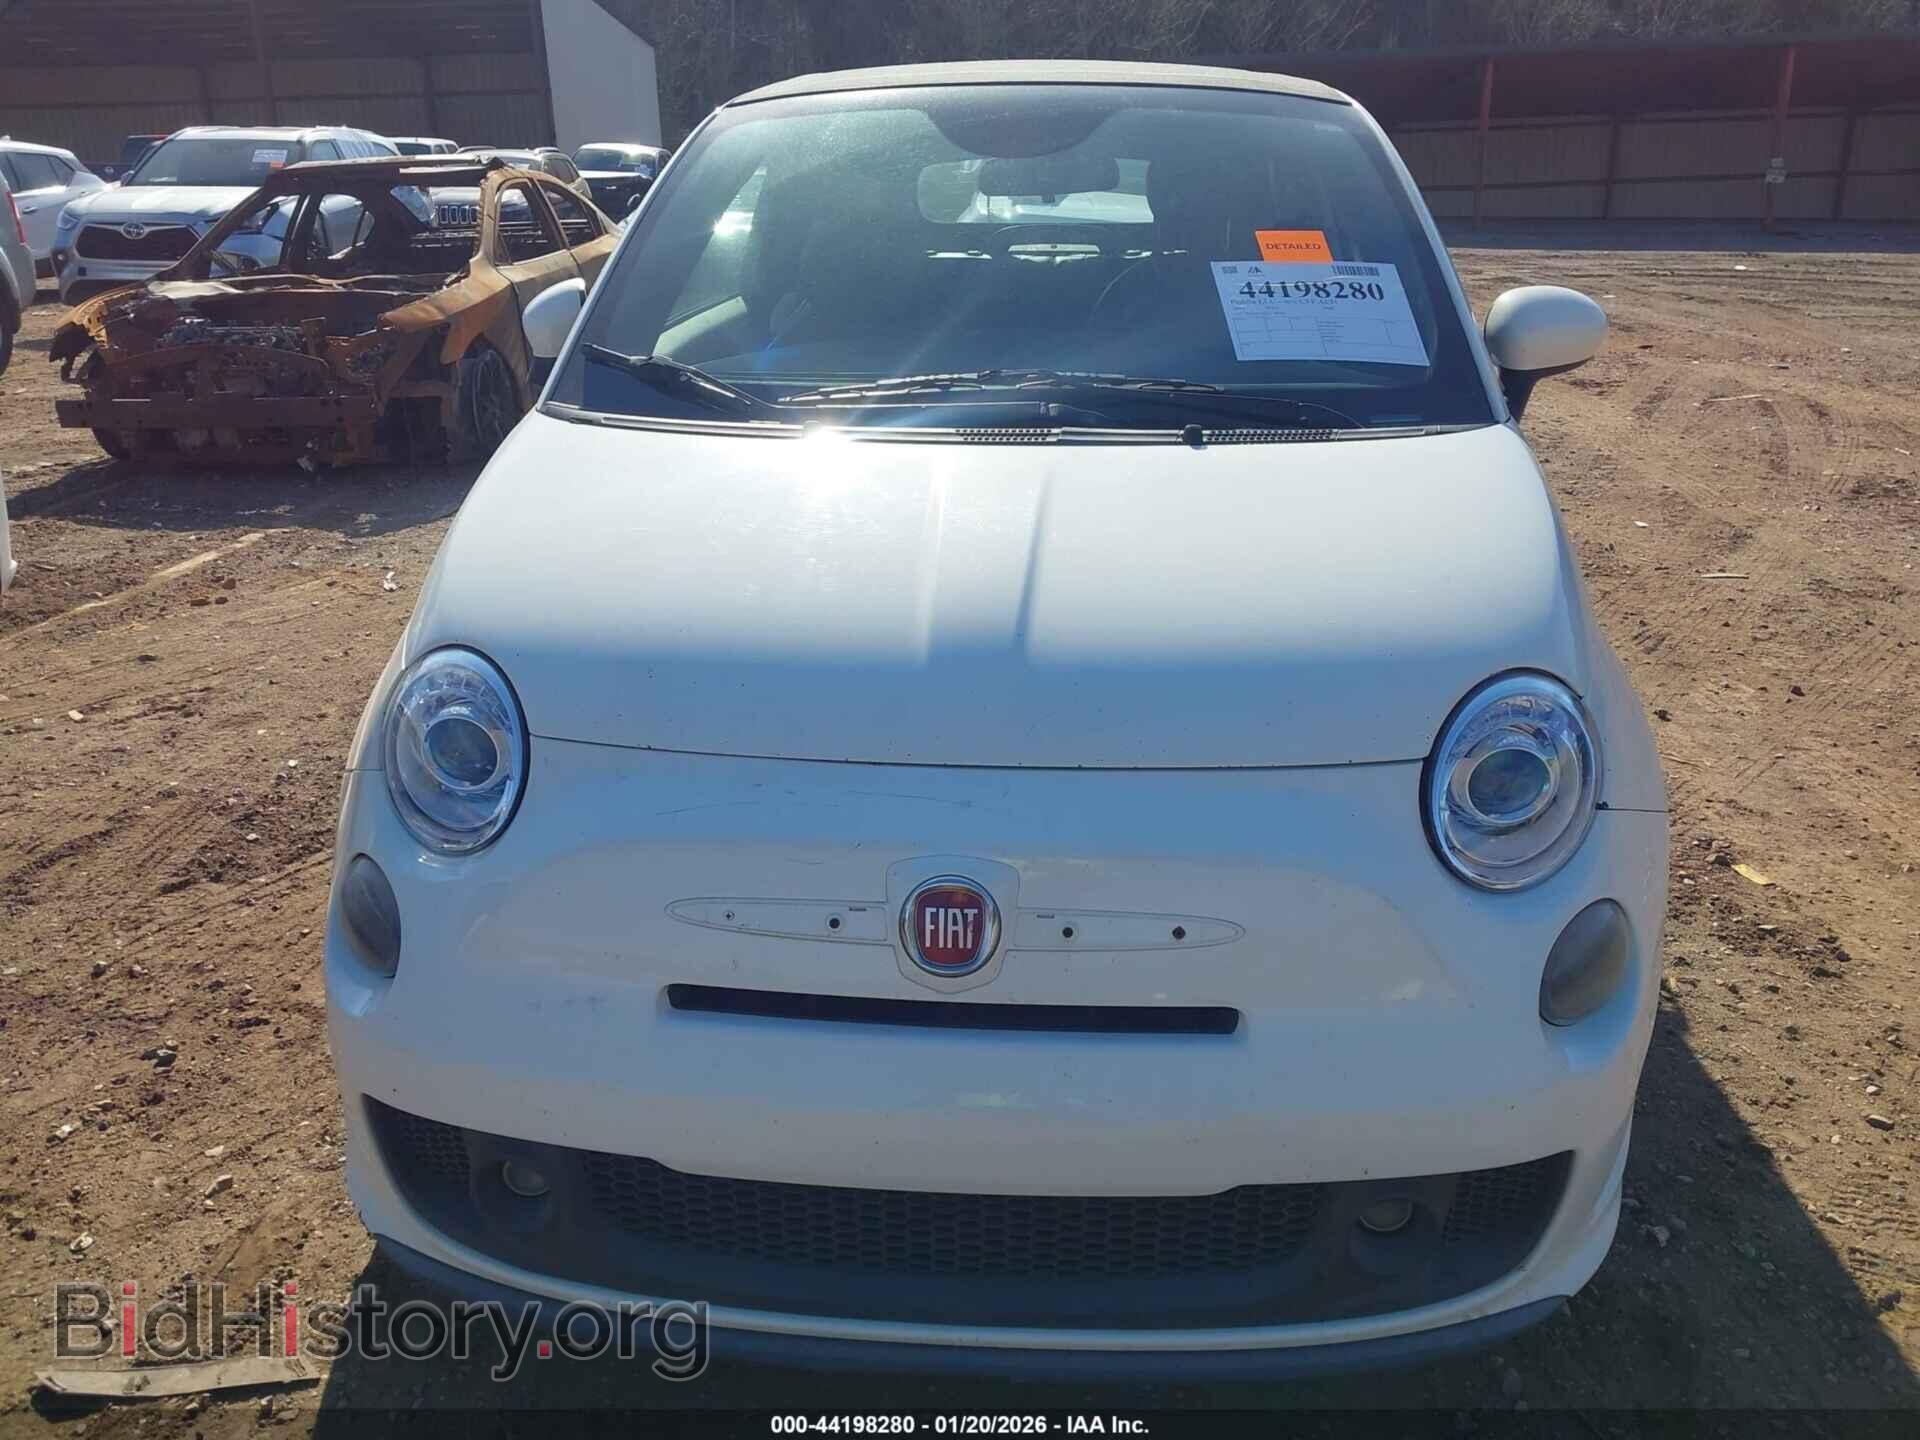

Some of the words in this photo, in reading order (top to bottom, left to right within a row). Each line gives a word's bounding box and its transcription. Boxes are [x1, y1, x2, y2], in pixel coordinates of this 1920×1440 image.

[1265, 242, 1322, 250] DETAILED
[1239, 281, 1385, 301] 44198280
[924, 906, 979, 949] FIAT
